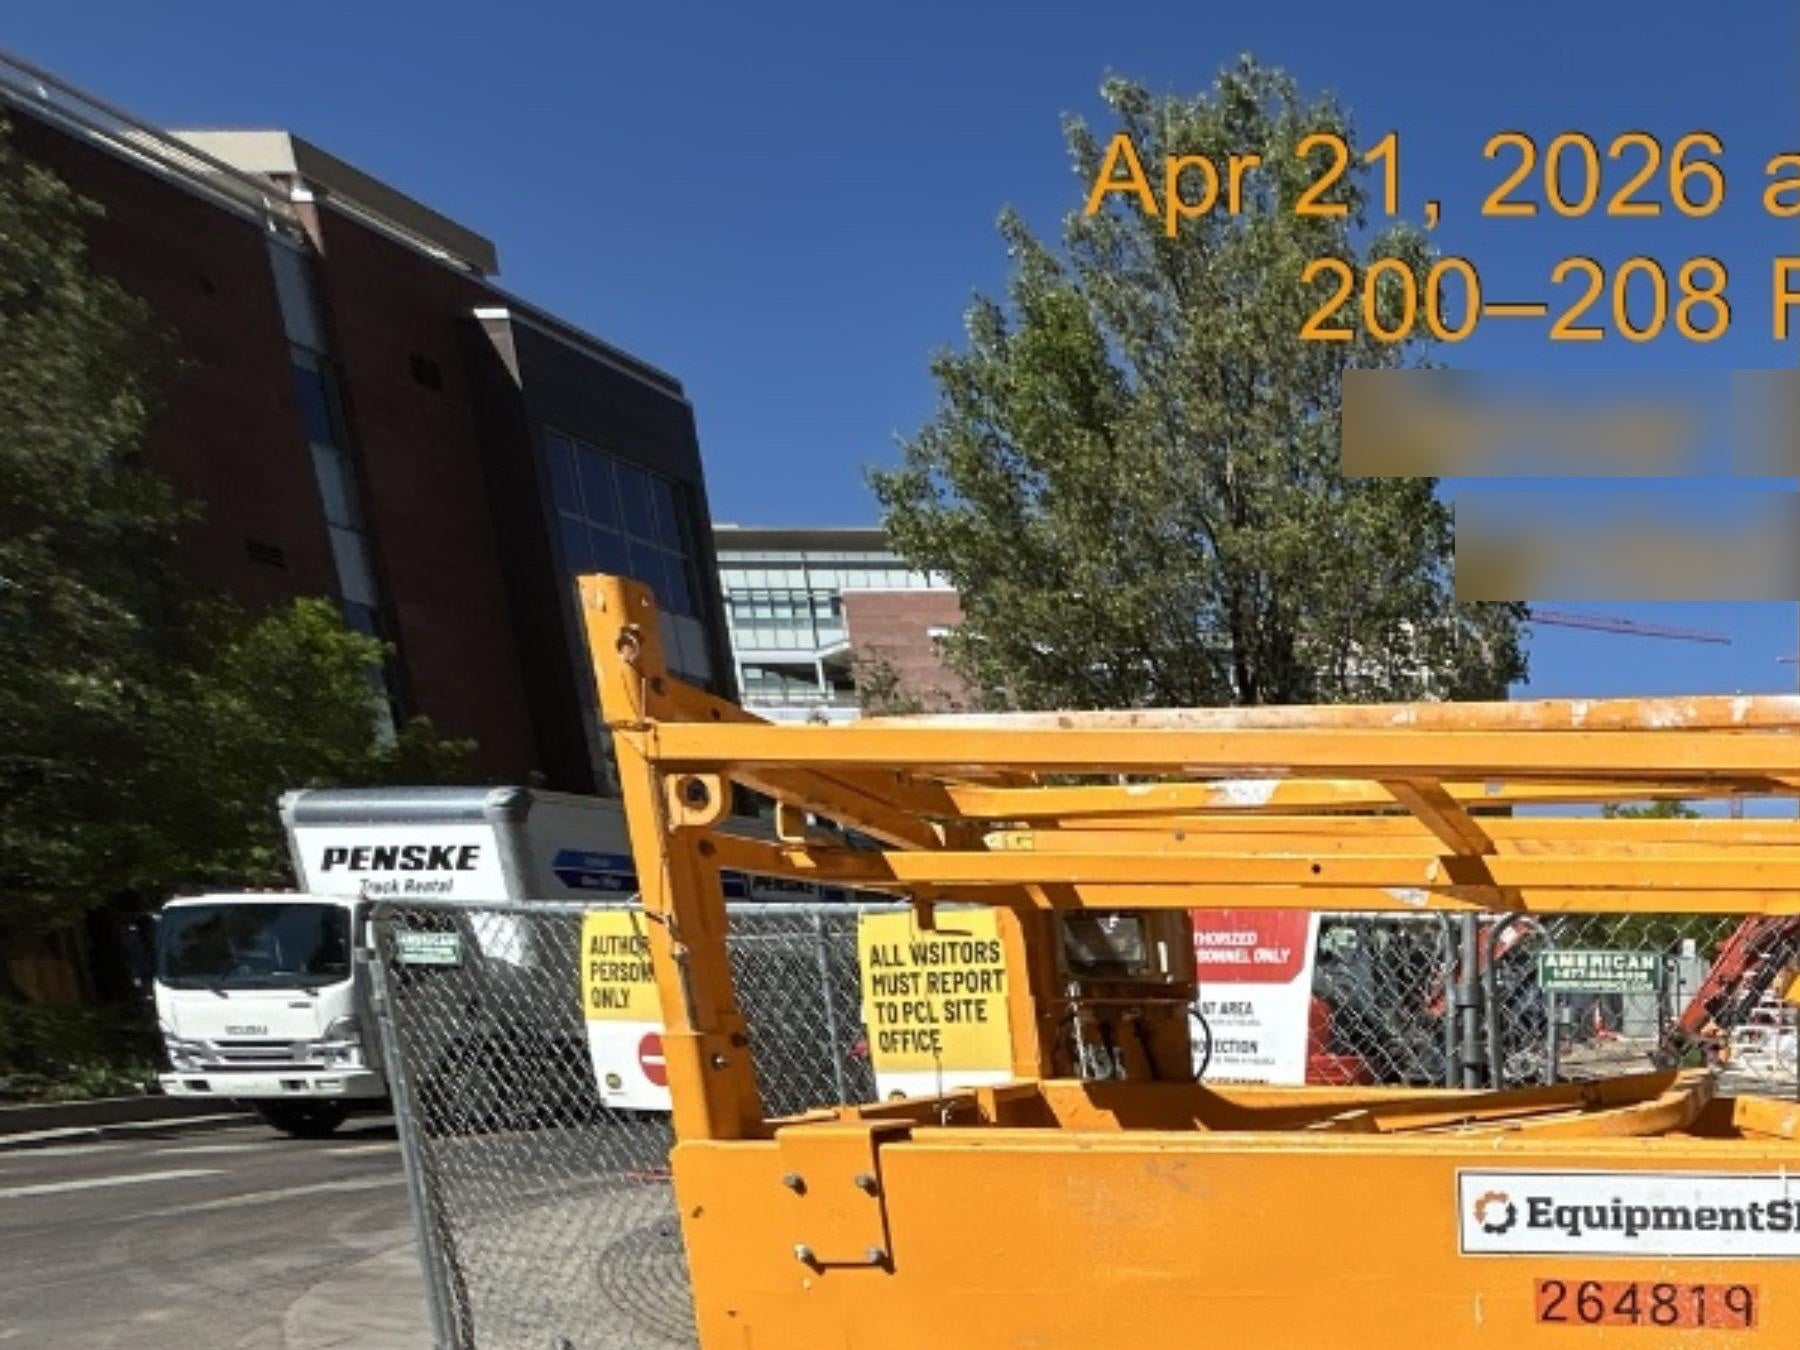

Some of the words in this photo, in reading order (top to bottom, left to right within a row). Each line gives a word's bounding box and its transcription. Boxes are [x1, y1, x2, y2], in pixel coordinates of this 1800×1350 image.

[321, 844, 481, 871] PENSKE
[360, 878, 399, 894] Truck
[404, 878, 454, 894] Rental
[870, 944, 906, 969] ALL
[909, 940, 1001, 968] VISITORS
[1253, 948, 1291, 964] ONLY
[1544, 955, 1654, 970] AMERICAN
[871, 971, 921, 997] MUST
[926, 969, 1006, 996] REPORT
[590, 987, 630, 1009] ONLY
[875, 1001, 898, 1024] TO
[903, 1000, 940, 1024] PCL
[944, 998, 988, 1023] SITE
[878, 1029, 943, 1055] OFFICE
[1540, 1279, 1754, 1327] 264819
